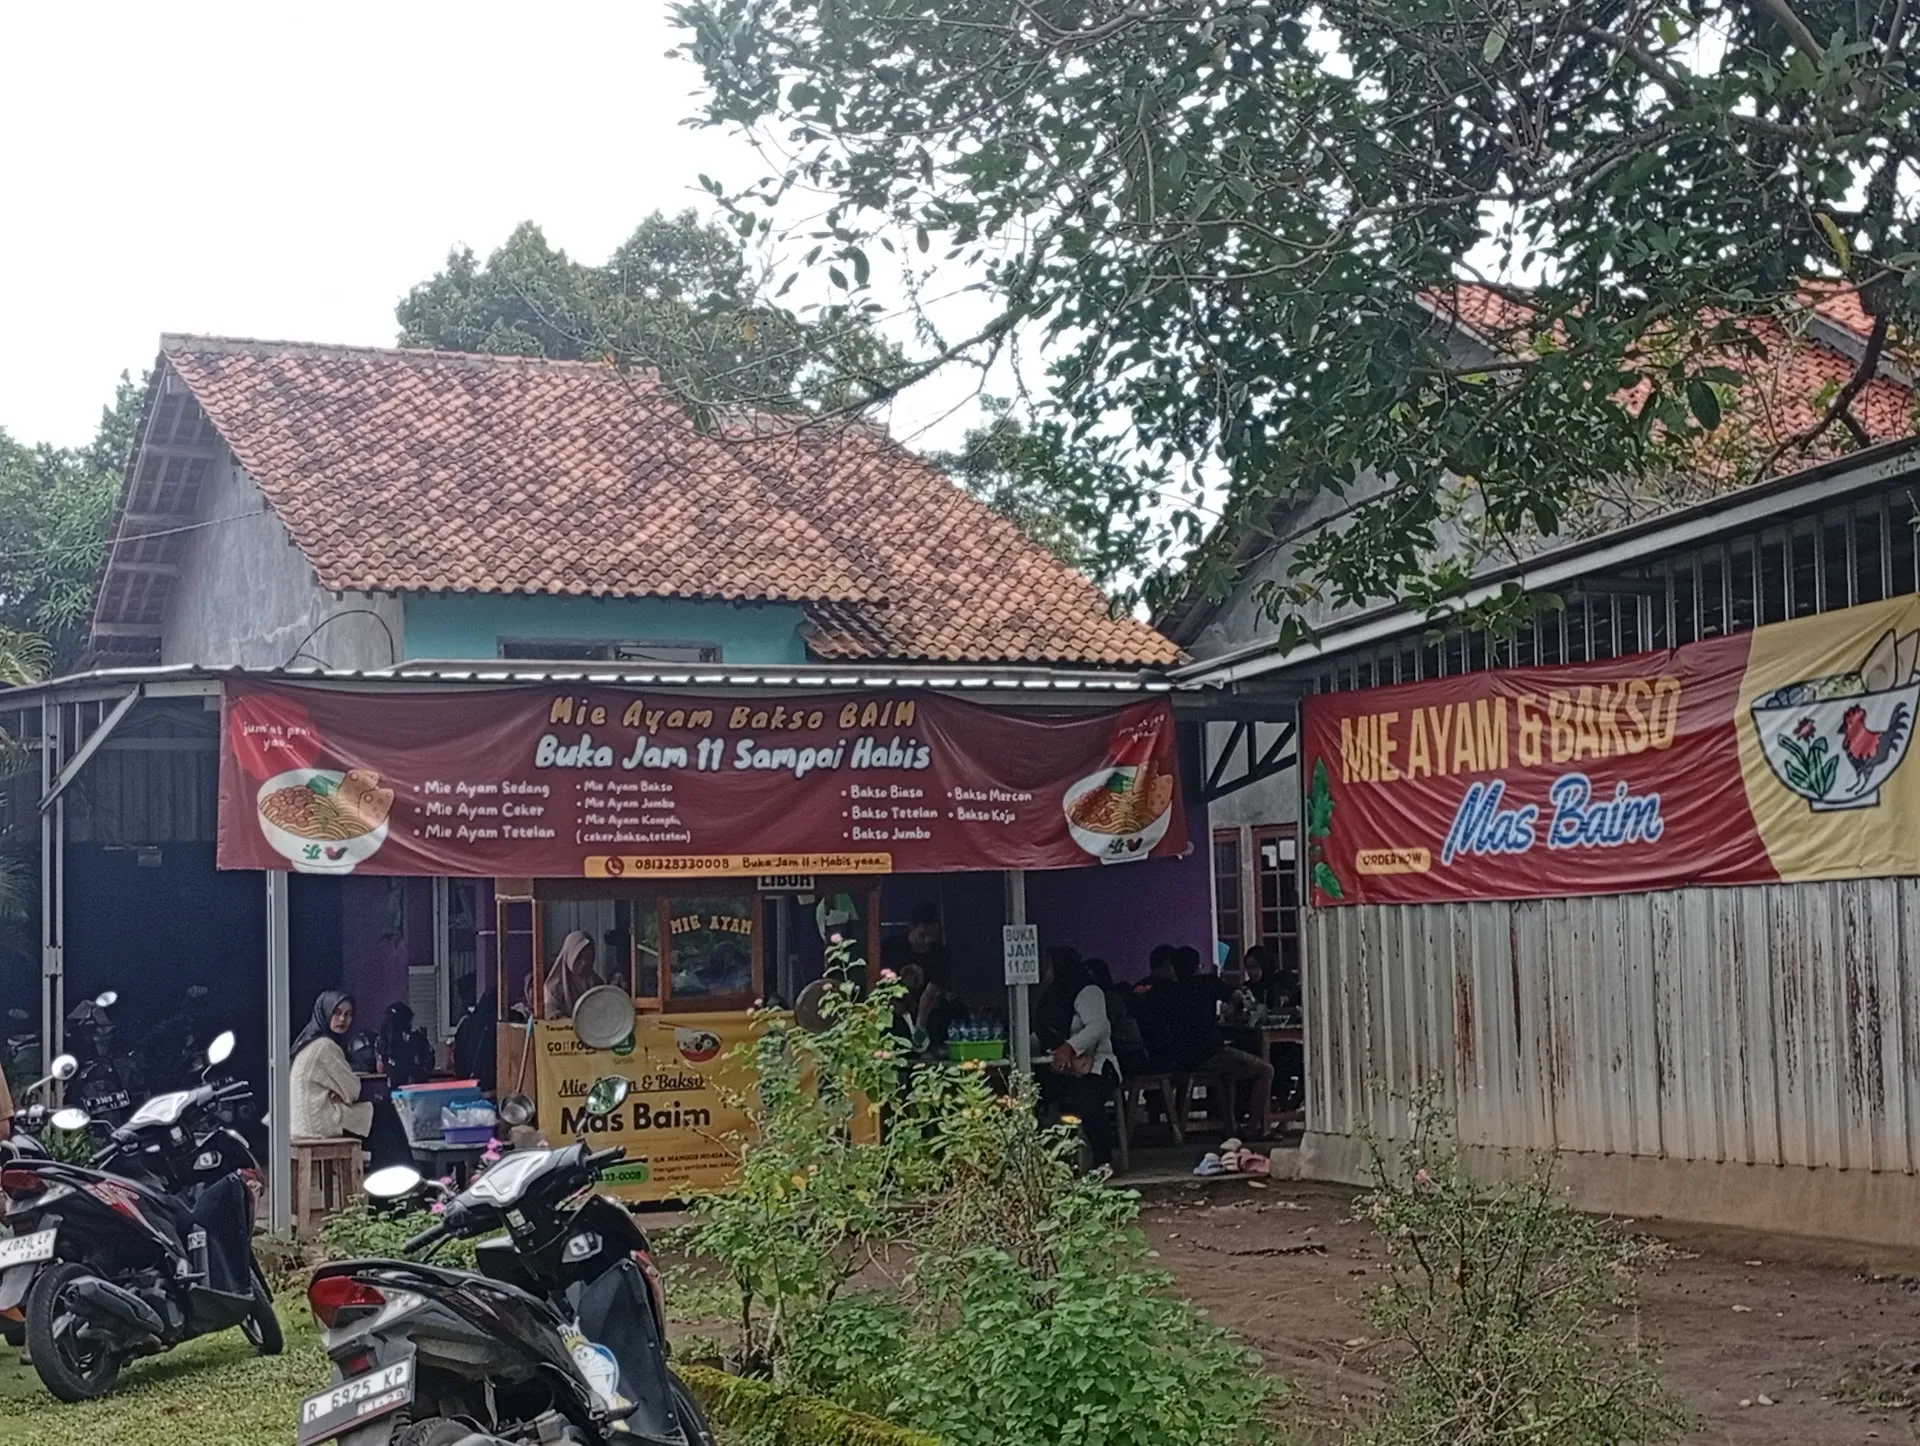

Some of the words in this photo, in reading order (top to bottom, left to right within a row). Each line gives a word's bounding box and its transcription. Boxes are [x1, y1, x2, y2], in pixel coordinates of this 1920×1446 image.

[551, 697, 607, 725] Mie
[623, 699, 713, 734] Ayam
[728, 705, 824, 730] Bakso
[839, 700, 916, 729] BAIM
[1340, 711, 1400, 785] MIE
[1407, 697, 1509, 779] AYAM
[1518, 694, 1544, 767] &
[1548, 675, 1682, 763] BAKSO
[535, 733, 614, 768] Buka
[622, 735, 688, 770] Jam
[697, 737, 725, 771] 11
[732, 738, 847, 779] Sampai
[850, 736, 931, 770] Habis
[424, 781, 451, 795] Mie
[456, 781, 498, 798] Ayam
[502, 780, 551, 798] Sedang
[584, 780, 604, 792] Mie
[607, 781, 638, 795] Ayam
[640, 781, 673, 792] Bakso
[850, 785, 887, 799] Bakso
[890, 784, 924, 798] Biasa
[954, 786, 988, 801] Bakso
[989, 789, 1032, 802] Mercon
[425, 801, 452, 817] Mie
[456, 802, 498, 821] Ayam
[502, 802, 545, 817] Ceker
[584, 797, 605, 809] Mie
[607, 798, 639, 812] Ayam
[641, 797, 675, 809] Jumbo
[851, 805, 888, 820] Bakso
[891, 806, 938, 819] Tetelan
[585, 813, 605, 825] Mie
[607, 814, 639, 828] Ayam
[957, 807, 989, 821] Bakso
[991, 809, 1016, 824] Keju
[1441, 779, 1539, 866] Mas
[1547, 772, 1664, 849] Baim
[424, 824, 452, 838] Mie
[456, 824, 498, 843] Ayam
[502, 824, 555, 838] Tetelan
[852, 826, 889, 840] Bakso
[892, 826, 931, 840] Jumbo
[635, 857, 730, 870] 081328330008
[742, 857, 772, 869] Buka
[775, 857, 799, 868] Jam
[820, 856, 851, 867] Habis
[670, 914, 701, 934] MIE
[709, 915, 753, 935] AYAM
[1005, 928, 1035, 941] BUKA
[1006, 943, 1036, 957] JAM
[1008, 960, 1036, 973] 11.00
[558, 1079, 588, 1095] Mie
[642, 1075, 653, 1090] &
[655, 1071, 704, 1090] Bakso
[561, 1106, 624, 1135] Mas
[634, 1101, 711, 1130] Baim
[308, 1403, 317, 1421] R
[384, 1366, 404, 1388] KP
